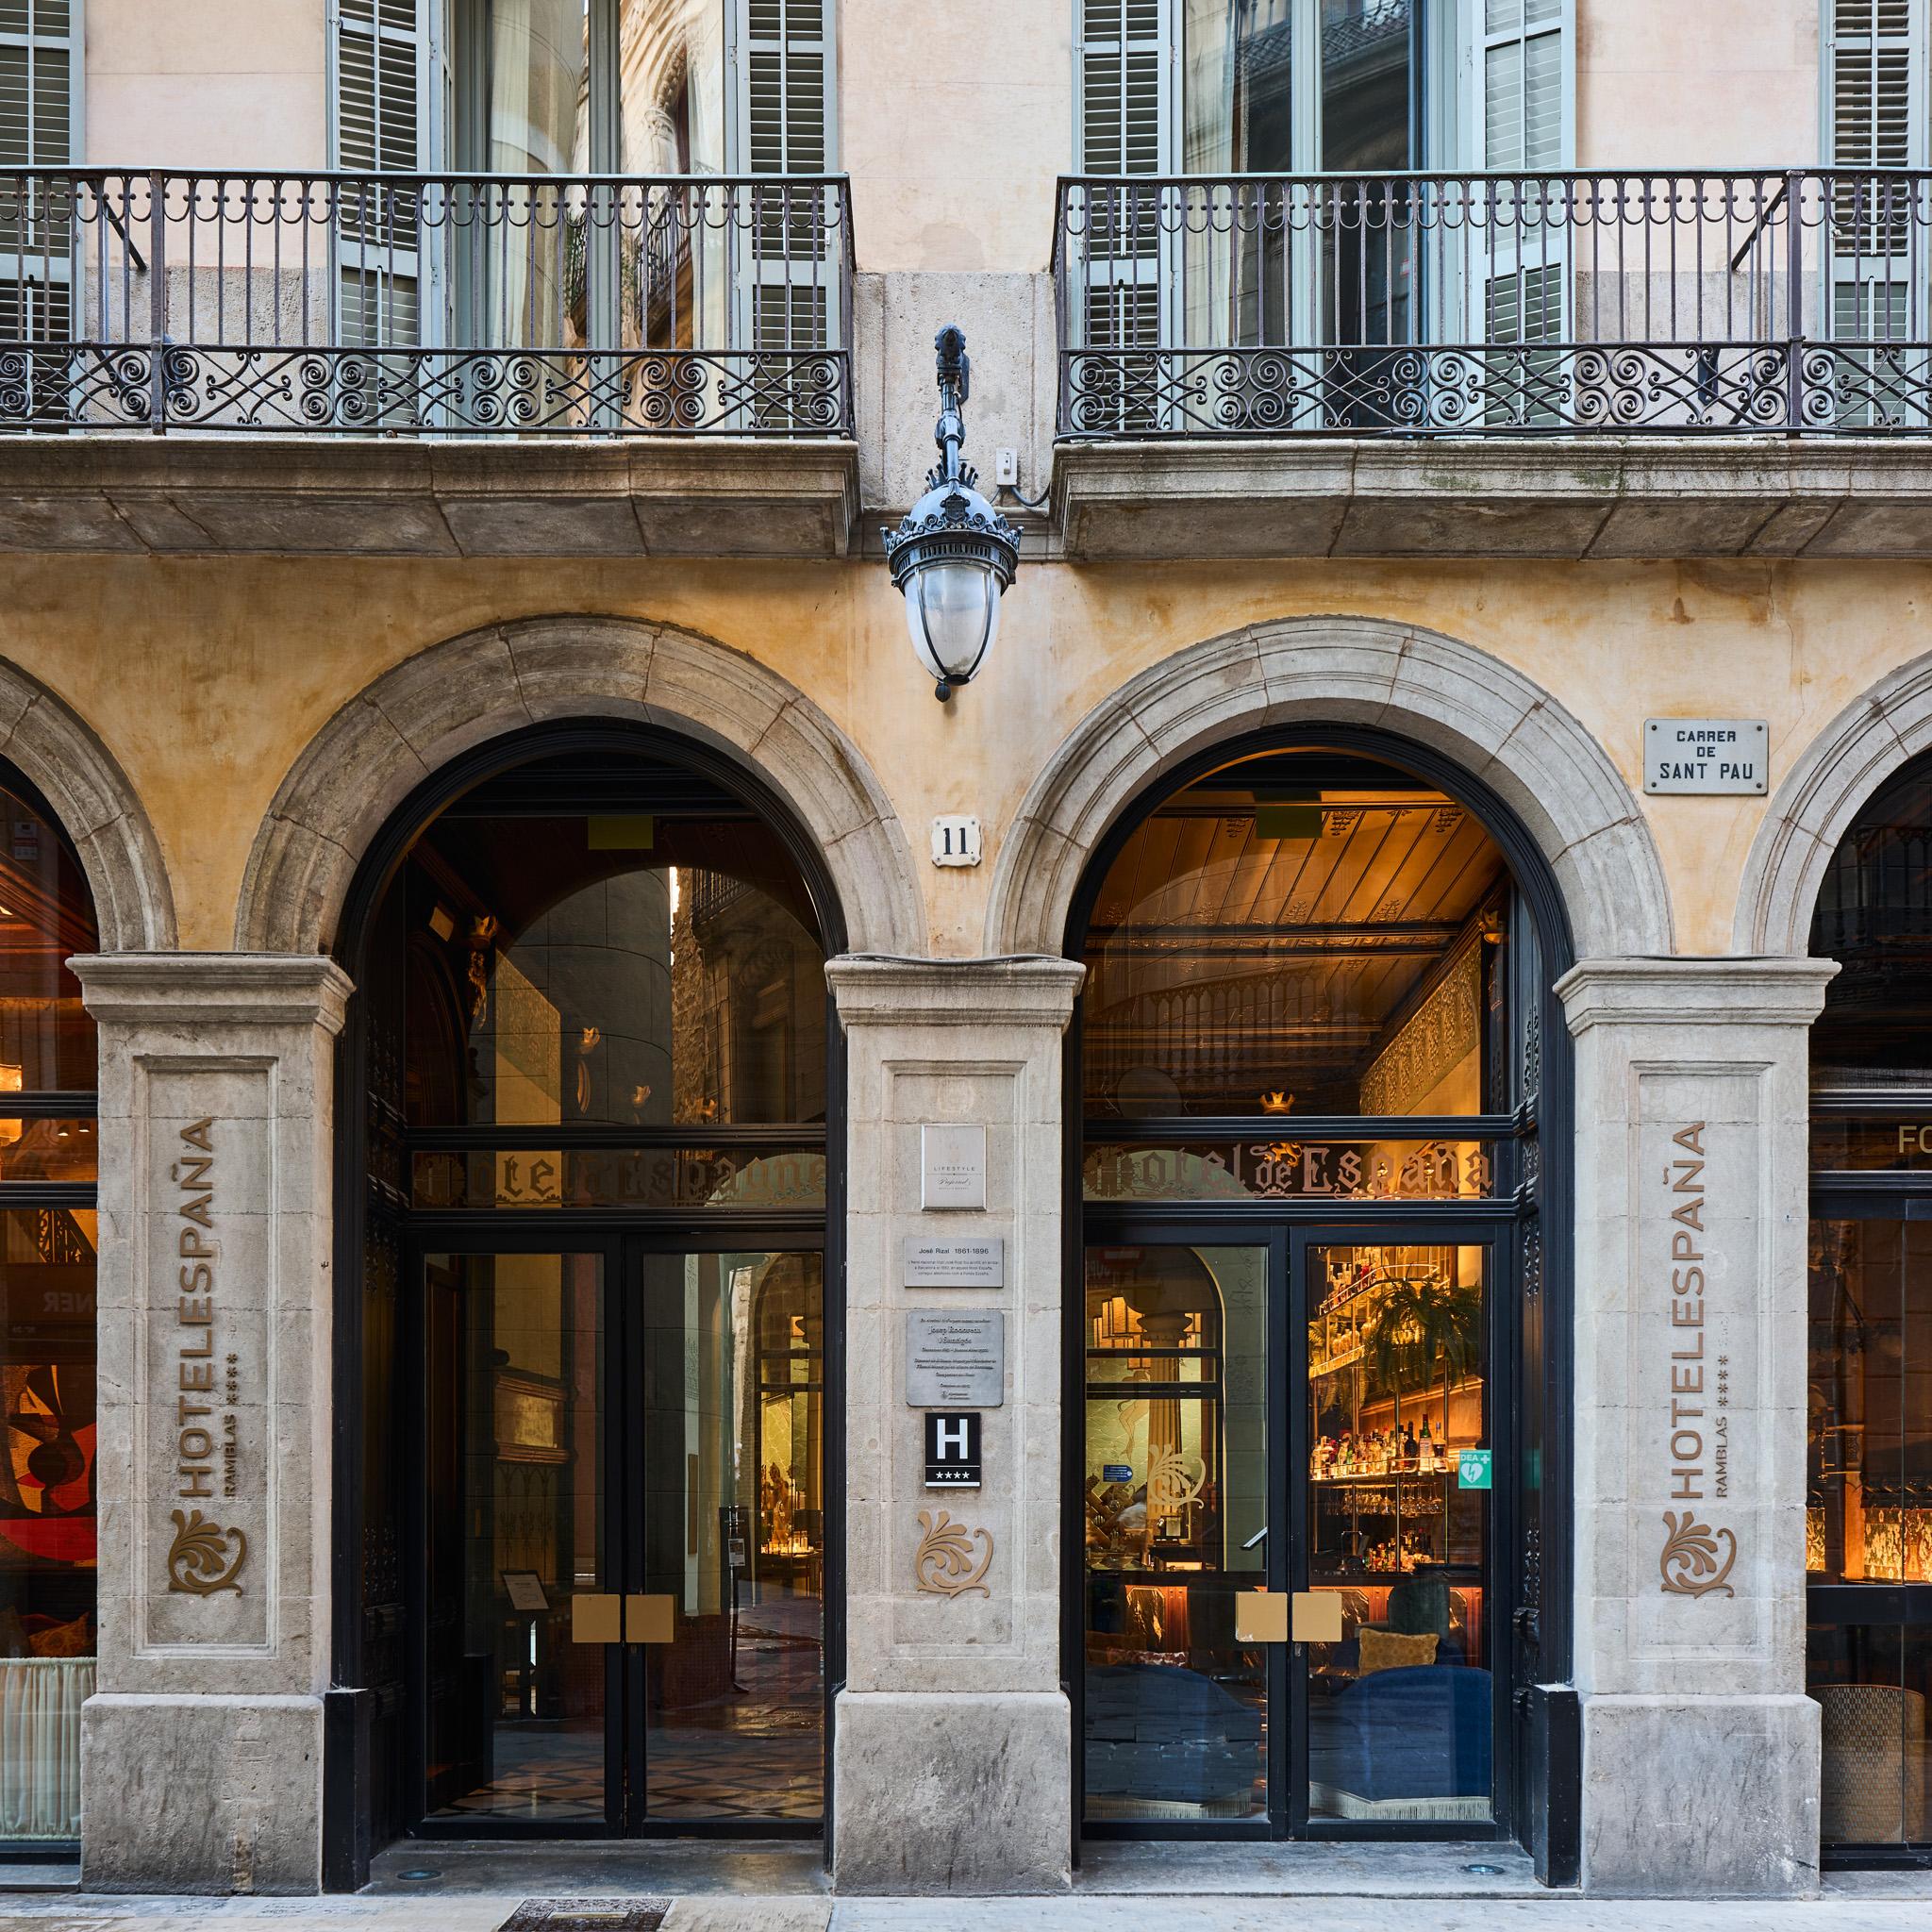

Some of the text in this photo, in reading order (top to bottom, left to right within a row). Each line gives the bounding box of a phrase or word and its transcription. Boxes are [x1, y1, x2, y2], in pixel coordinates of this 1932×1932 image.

[1676, 730, 1737, 742] CARRER
[1696, 746, 1716, 758] DE
[1659, 762, 1753, 779] SANT PAU
[942, 827, 969, 856] 11
[937, 1418, 969, 1459] H
[225, 1414, 237, 1497] RAMBLAS
[1715, 1416, 1728, 1498] RAMBLAS
